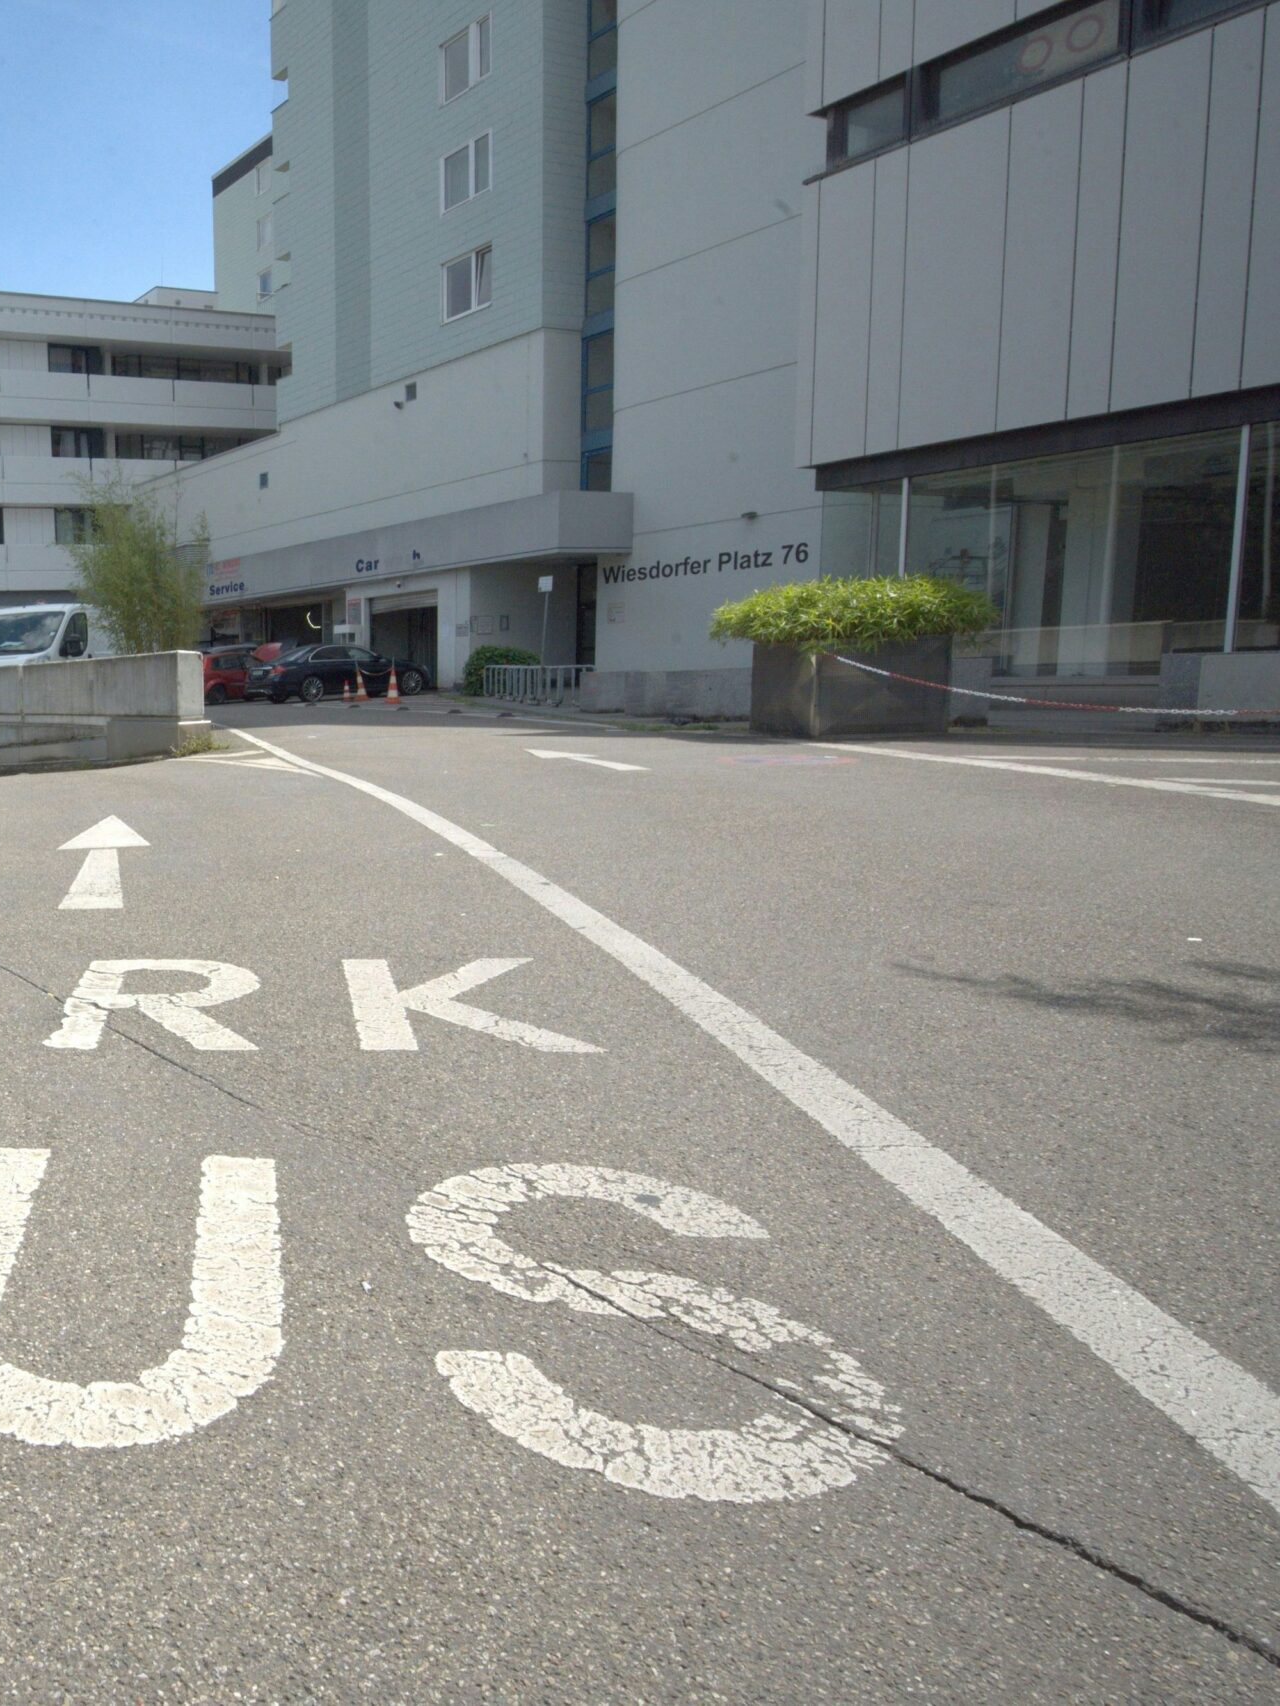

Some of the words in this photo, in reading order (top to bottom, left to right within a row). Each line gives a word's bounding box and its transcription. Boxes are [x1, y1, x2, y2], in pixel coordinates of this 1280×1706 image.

[355, 558, 380, 573] Car
[602, 556, 712, 585] Wiesdorfer
[717, 549, 773, 573] Platz
[780, 542, 810, 566] 76
[209, 580, 245, 596] Service
